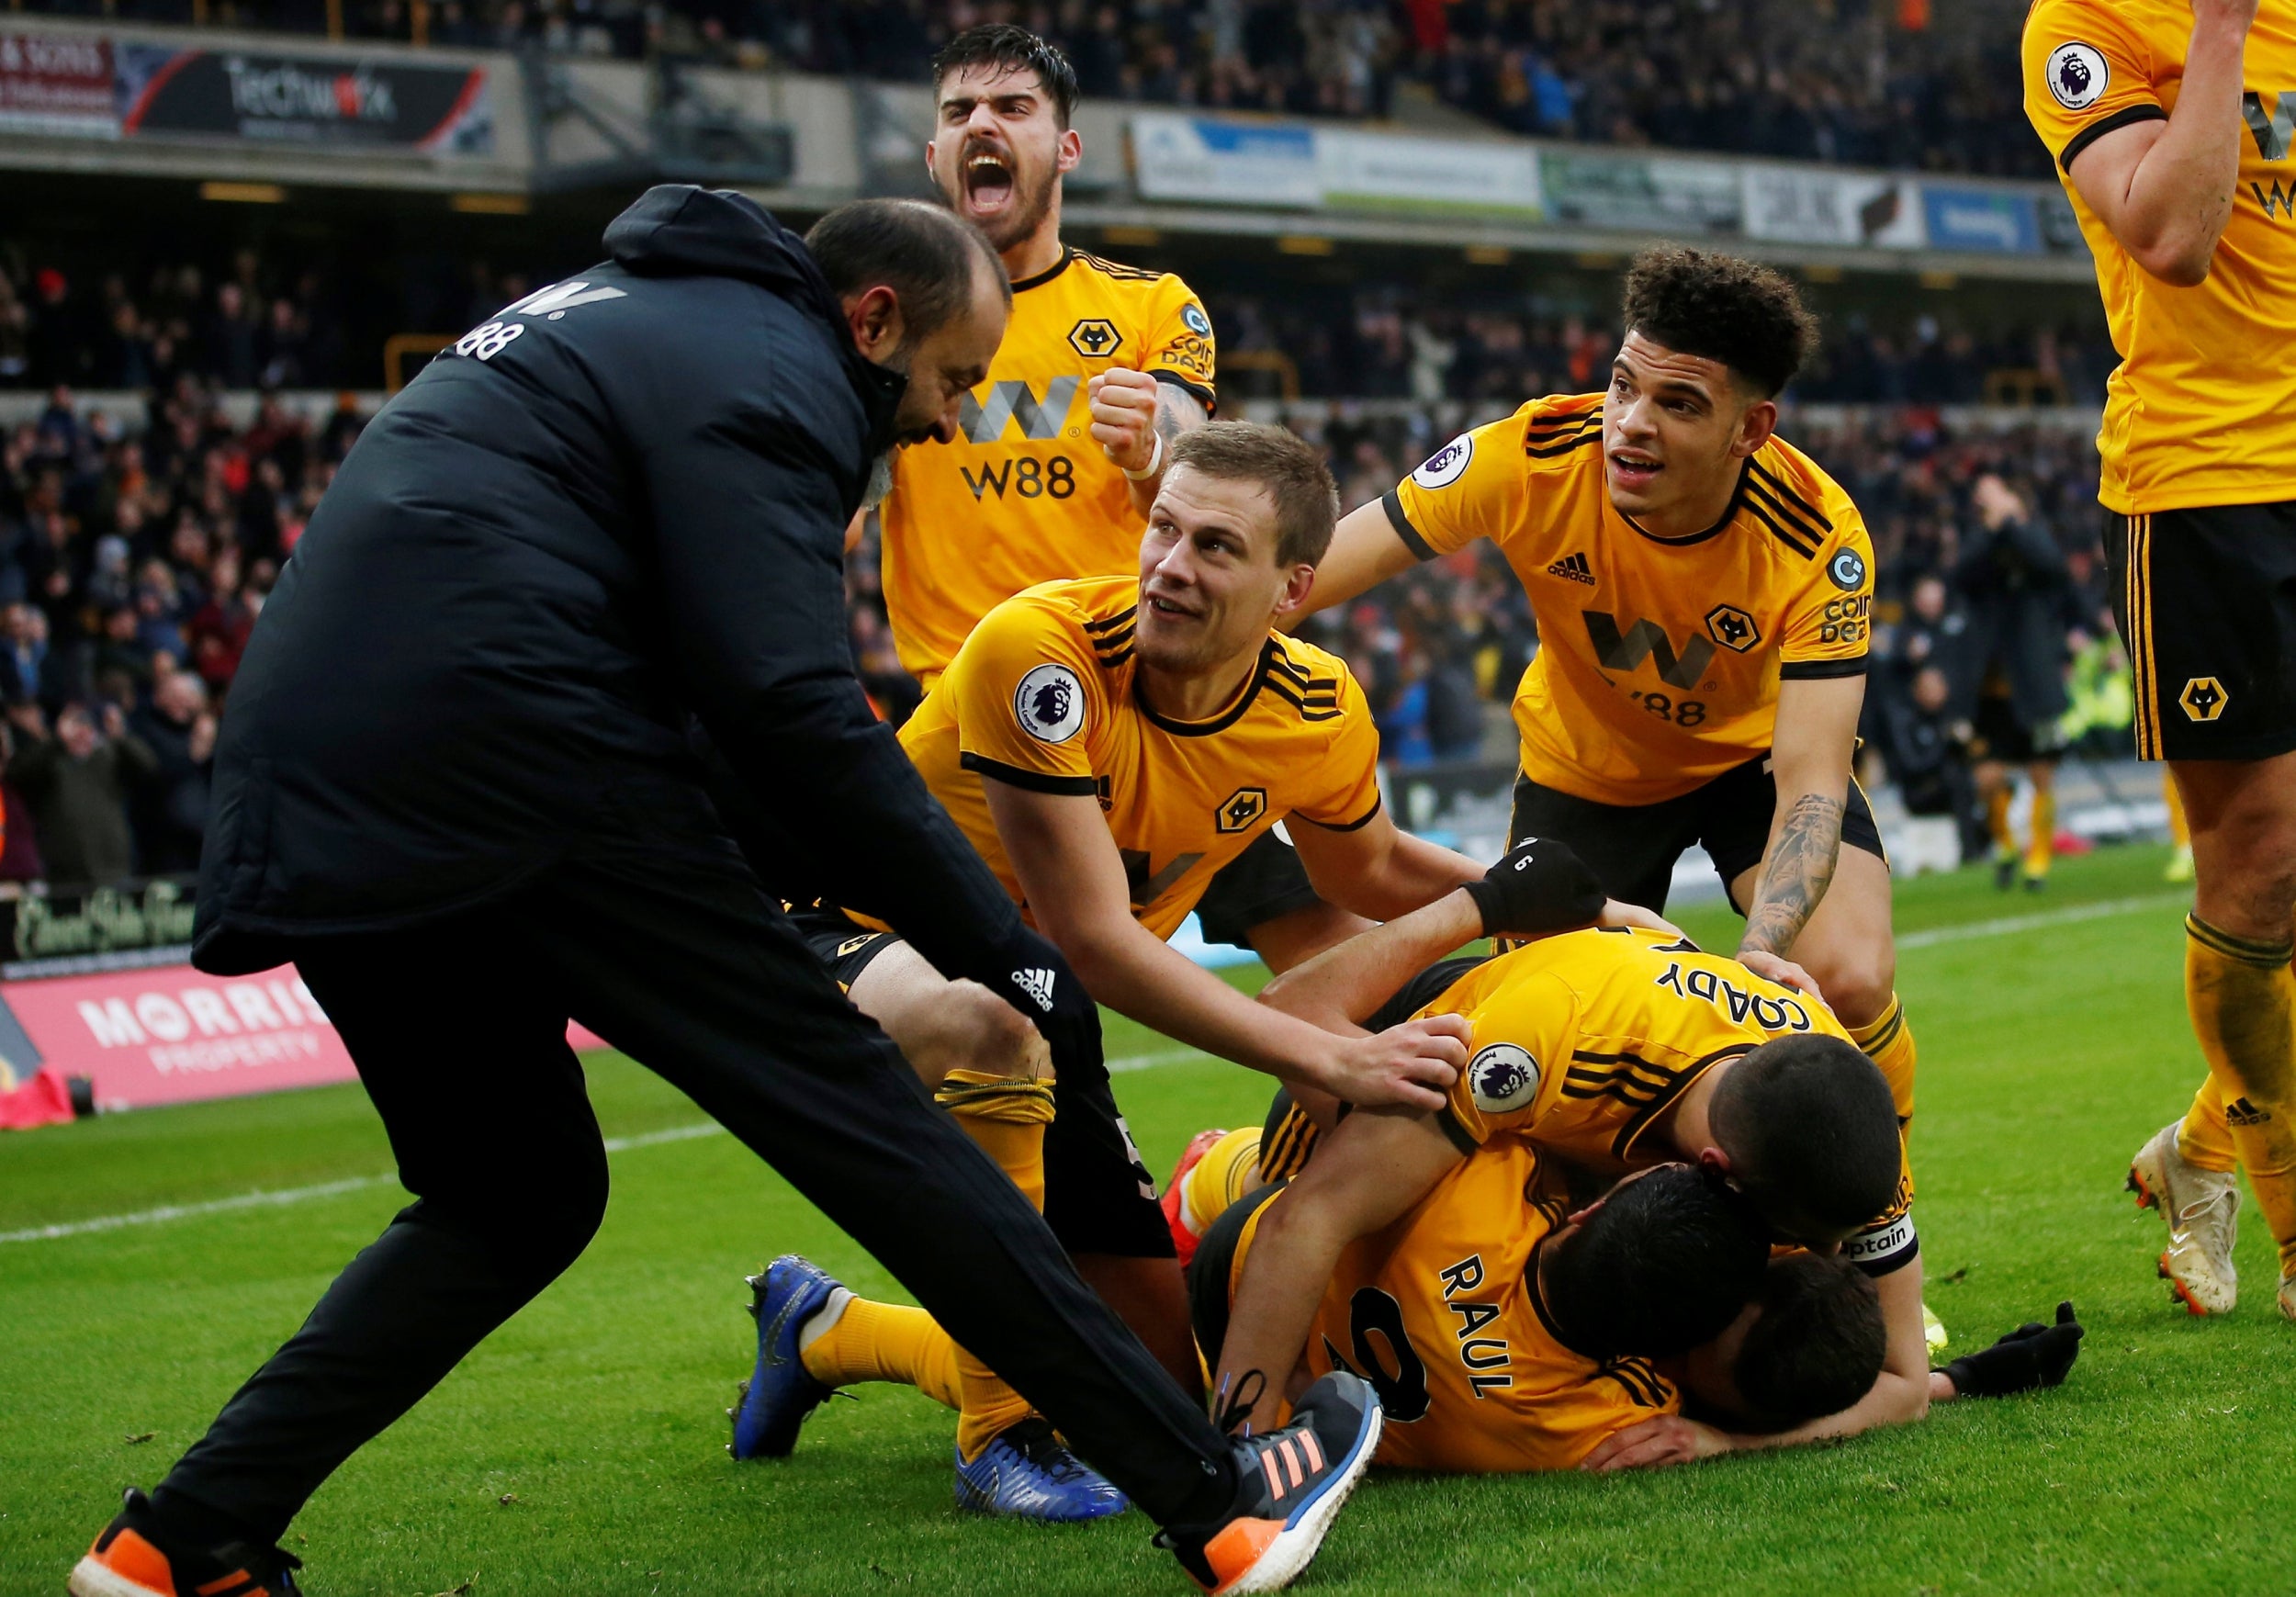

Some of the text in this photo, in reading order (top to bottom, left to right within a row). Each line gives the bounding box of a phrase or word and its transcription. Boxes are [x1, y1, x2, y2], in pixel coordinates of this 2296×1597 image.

[450, 321, 524, 361] 88
[960, 455, 1076, 502] W88
[1548, 565, 1596, 586] adidas
[1514, 854, 1535, 872] 6
[1011, 971, 1053, 1012] adidas
[1653, 962, 1812, 1032] COADY
[147, 1029, 320, 1077] PROPERTY
[1438, 1253, 1514, 1400] RAUL
[1321, 1286, 1431, 1423] 9
